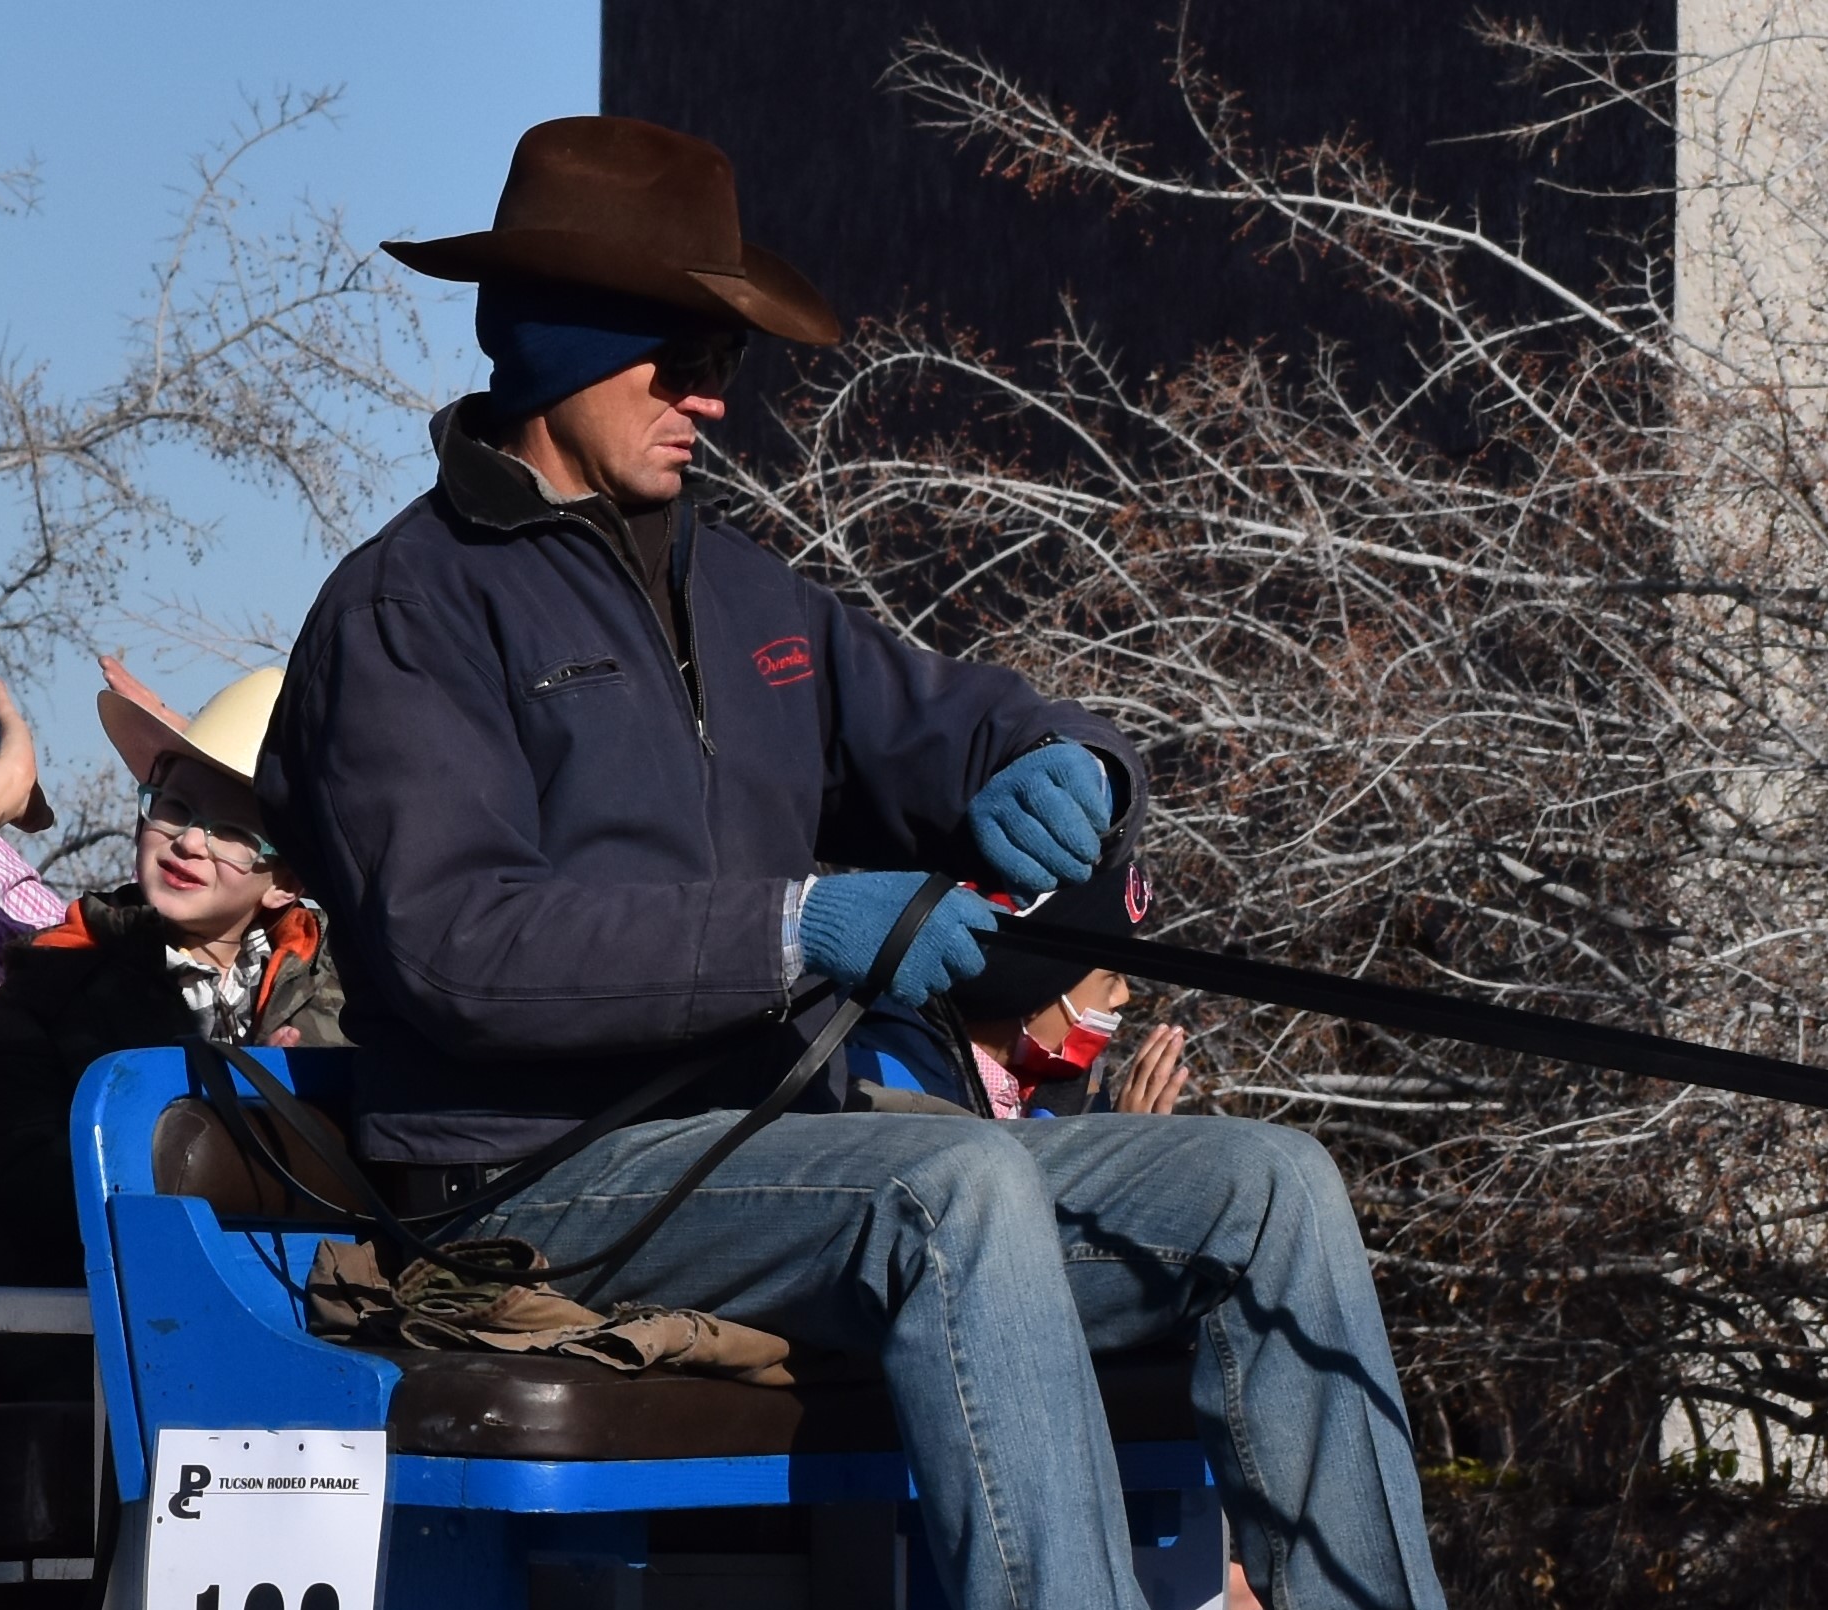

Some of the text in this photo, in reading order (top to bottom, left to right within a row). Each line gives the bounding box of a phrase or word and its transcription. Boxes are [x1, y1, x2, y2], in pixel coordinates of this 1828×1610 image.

[219, 1477, 360, 1491] TUCSON RODEO PARADE
